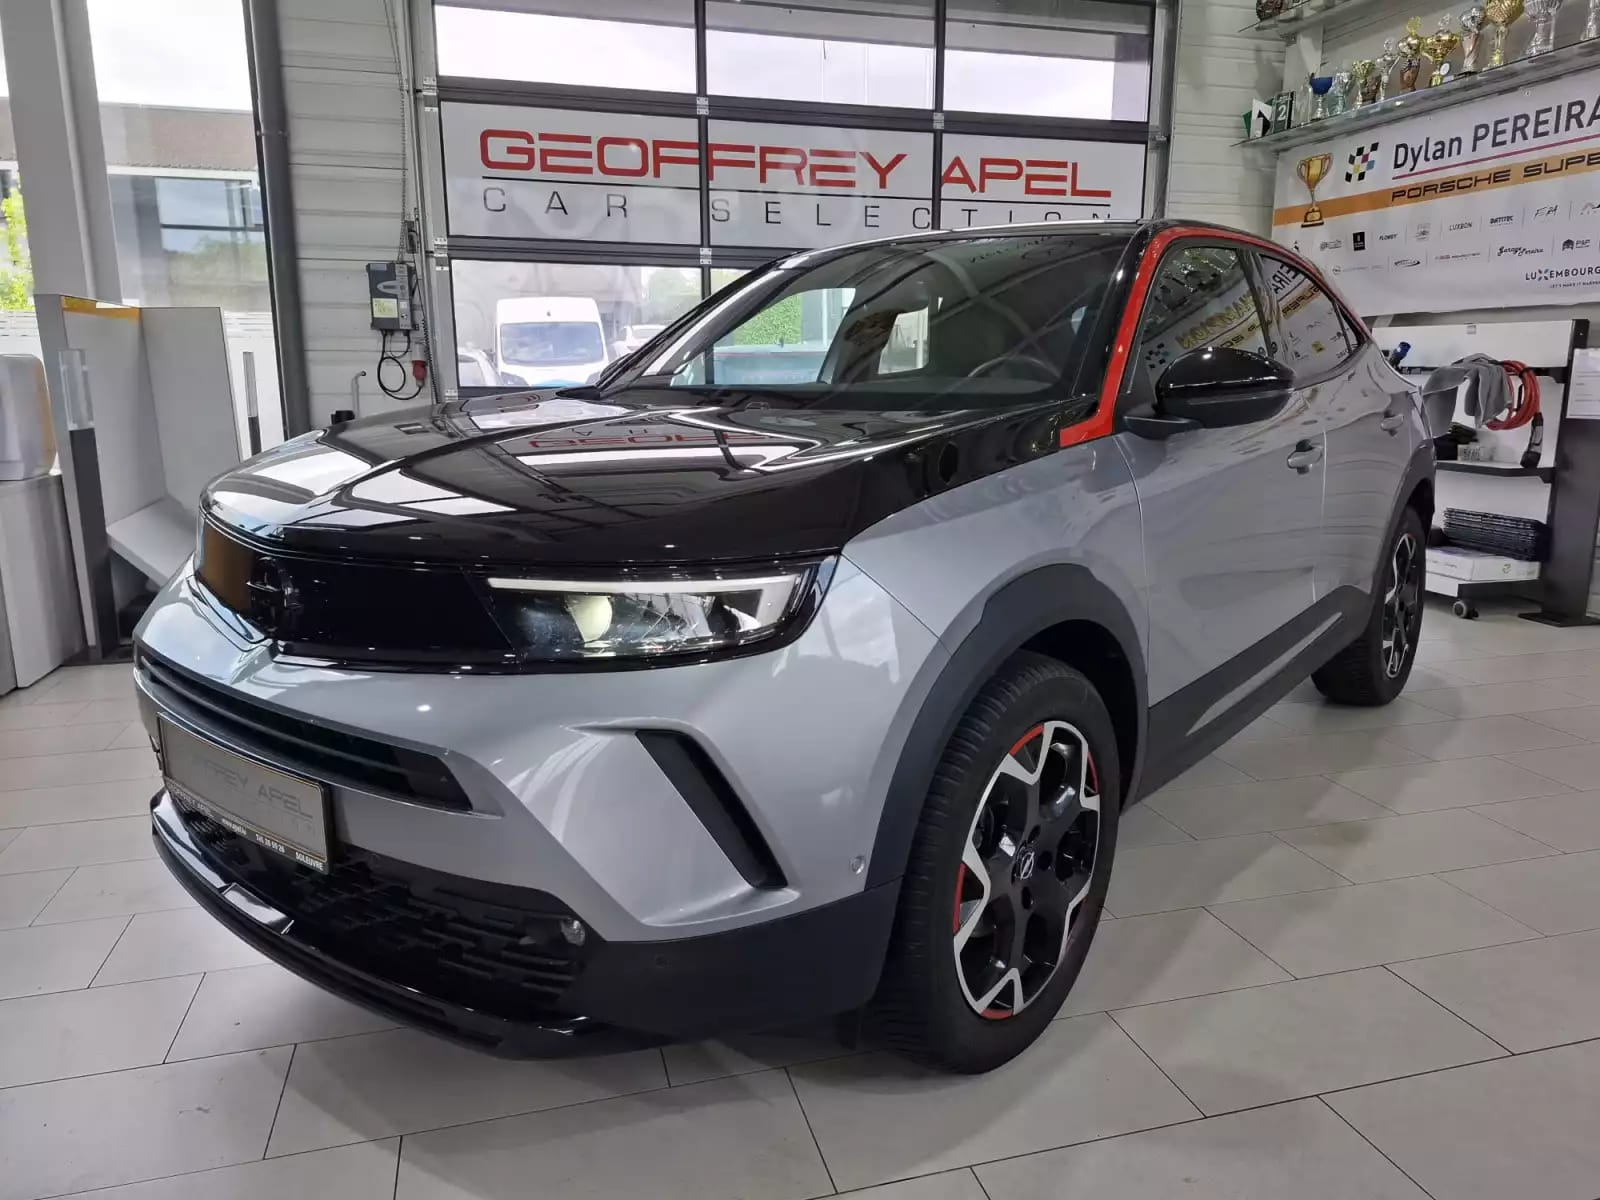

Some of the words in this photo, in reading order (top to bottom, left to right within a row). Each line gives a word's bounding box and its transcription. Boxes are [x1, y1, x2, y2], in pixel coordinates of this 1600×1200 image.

[1277, 104, 1287, 121] 2
[1393, 136, 1462, 171] Dylan
[1472, 97, 1600, 153] PEREIRA
[480, 129, 907, 189] GEOFFREY
[941, 156, 1111, 197] APEL
[1392, 169, 1511, 201] PORSCHE
[483, 187, 627, 218] CAR
[712, 199, 1110, 230] SELECTI
[1525, 266, 1600, 281] LUXEMBOURG
